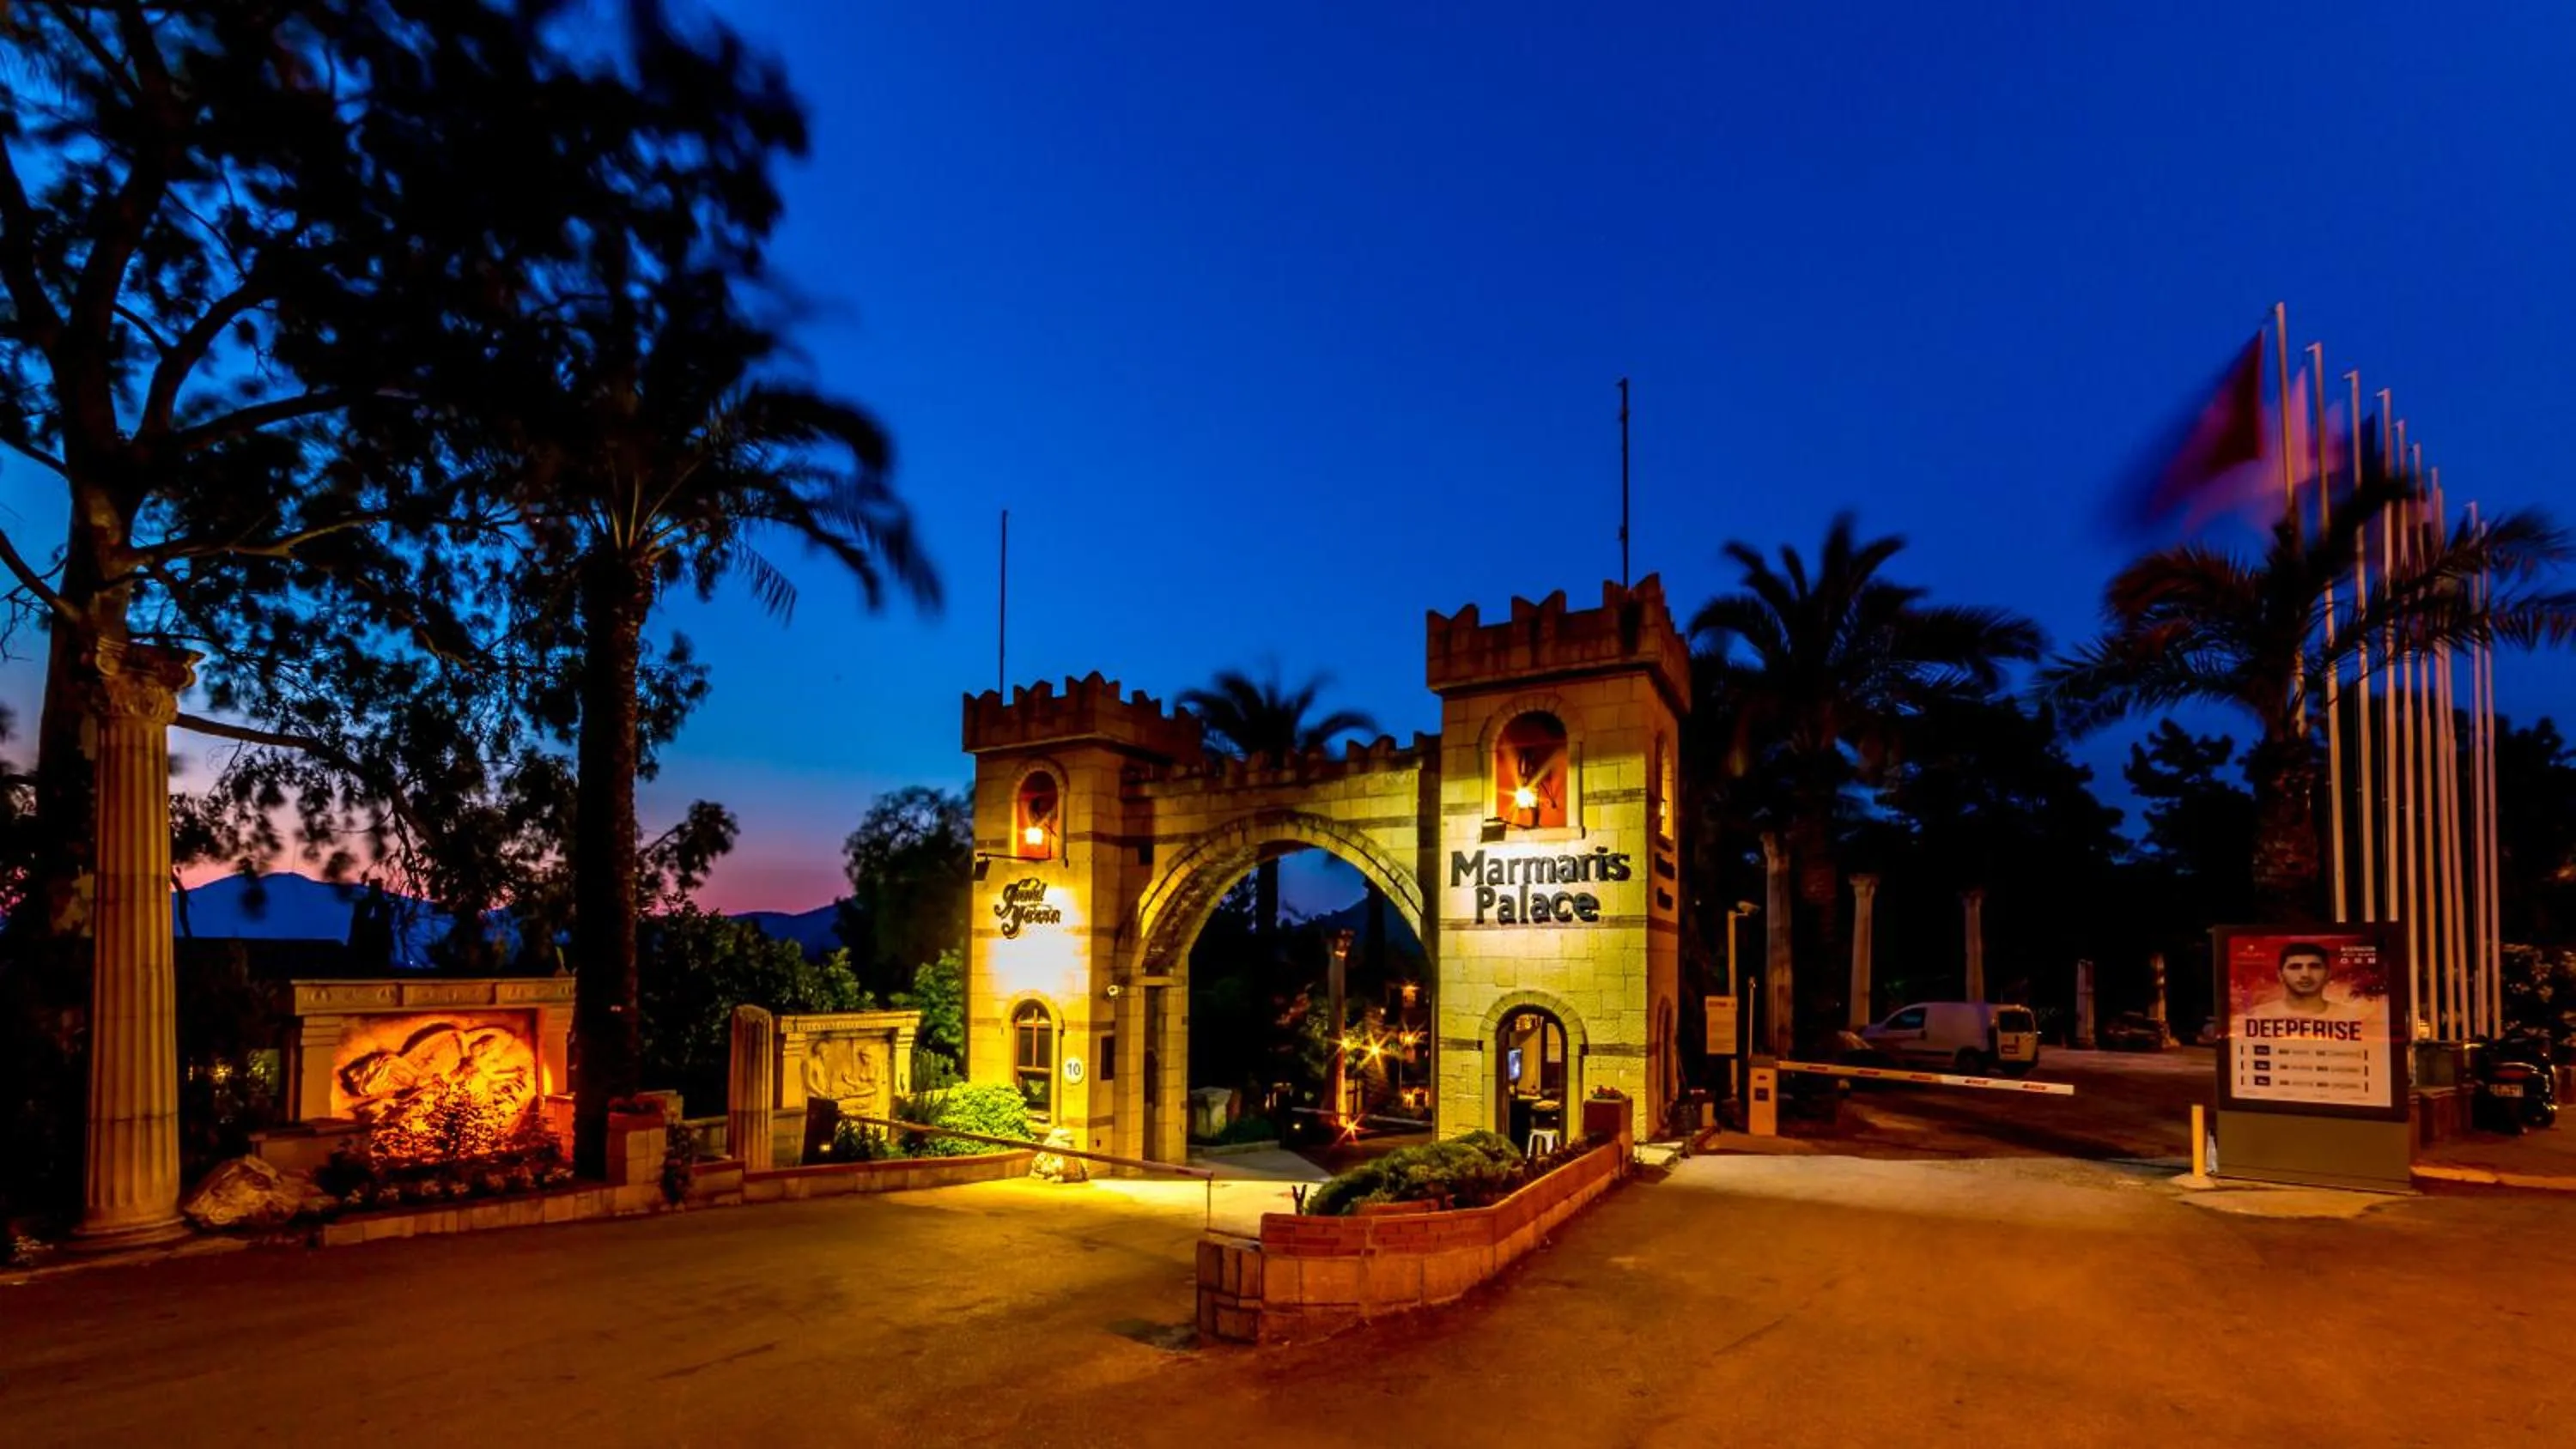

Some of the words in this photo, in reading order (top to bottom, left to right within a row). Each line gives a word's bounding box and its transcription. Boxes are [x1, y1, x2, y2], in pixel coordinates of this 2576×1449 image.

[1450, 846, 1631, 888] Marmaris
[1474, 885, 1601, 925] Palace
[1066, 1062, 1081, 1076] 10
